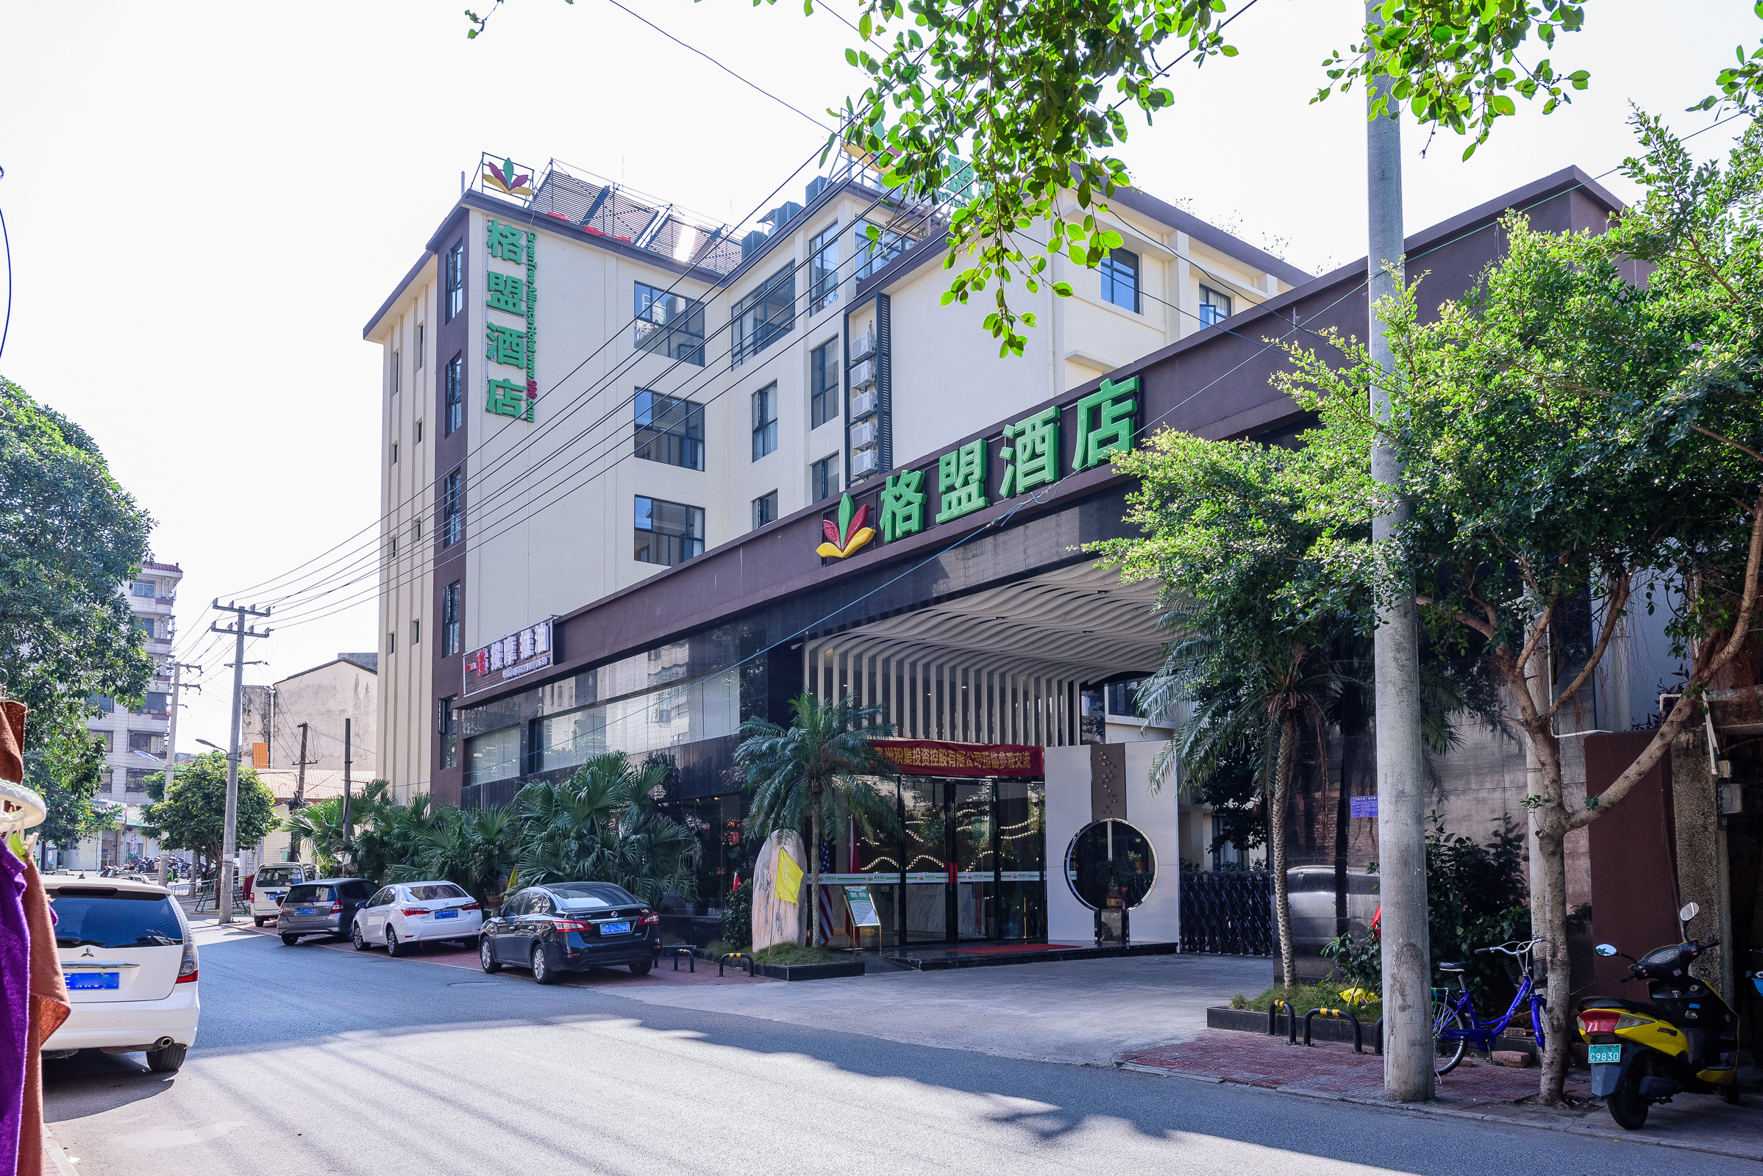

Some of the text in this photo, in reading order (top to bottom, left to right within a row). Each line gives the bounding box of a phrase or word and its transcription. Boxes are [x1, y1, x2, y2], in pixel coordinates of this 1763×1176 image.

[486, 218, 526, 419] 格盟酒店
[527, 284, 537, 324] Alliance
[527, 325, 537, 352] Hotel
[527, 354, 537, 422] www.998.com
[879, 377, 1140, 543] 格盟酒店
[1589, 1052, 1619, 1062] C9830
